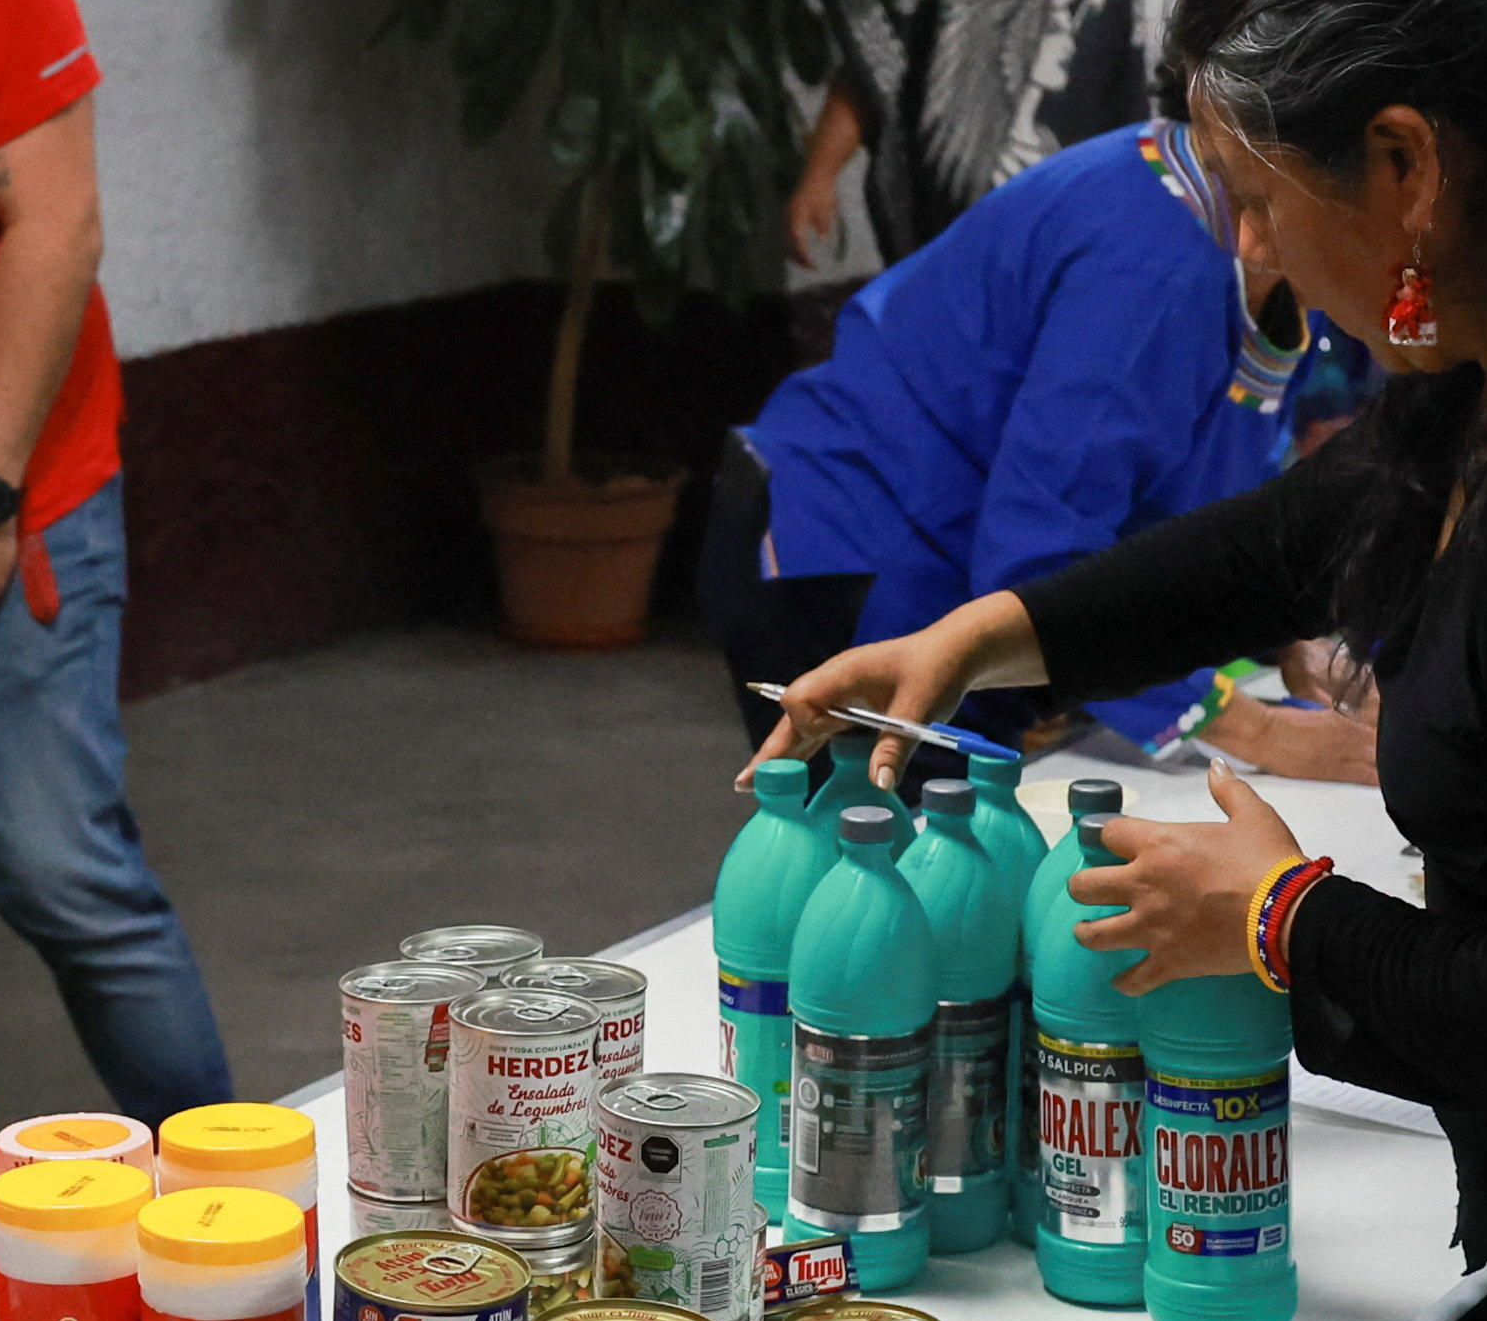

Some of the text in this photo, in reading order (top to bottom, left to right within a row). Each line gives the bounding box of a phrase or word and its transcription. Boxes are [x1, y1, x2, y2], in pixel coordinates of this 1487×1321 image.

[487, 1049, 590, 1080] HERDEZ
[1047, 1055, 1116, 1078] SALPICA
[507, 1082, 578, 1101] Ensalada
[487, 1098, 588, 1126] de Legumbres
[1153, 1094, 1211, 1113] DESINFECTA
[1053, 1153, 1087, 1178] GEL
[1159, 1193, 1178, 1210] EL
[1170, 1229, 1196, 1246] 50
[792, 1253, 844, 1282] Tuny
